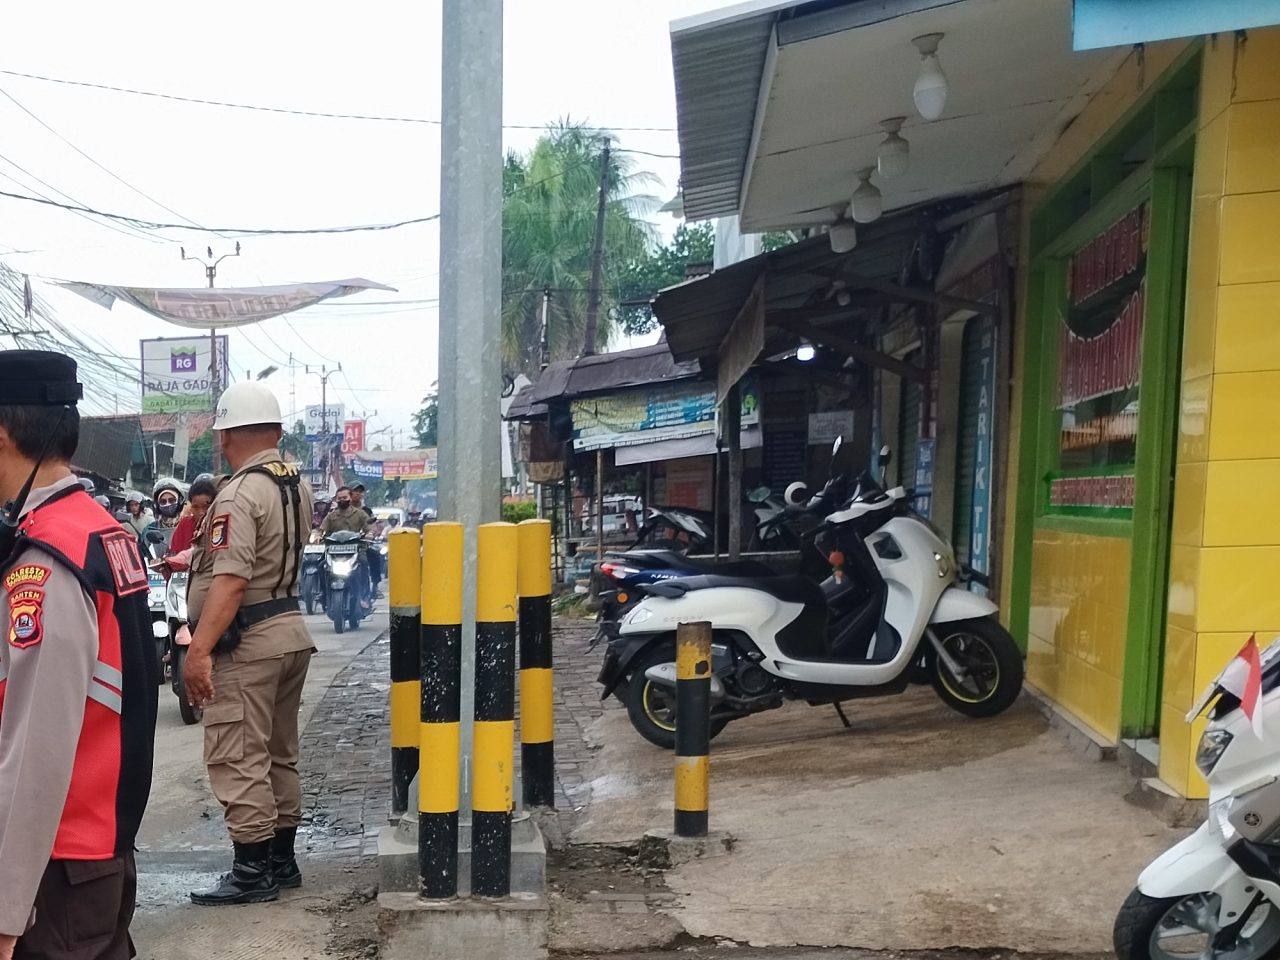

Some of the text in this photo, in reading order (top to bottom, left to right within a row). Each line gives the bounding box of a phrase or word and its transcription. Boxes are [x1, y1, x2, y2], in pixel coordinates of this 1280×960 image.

[176, 358, 192, 368] RG
[148, 380, 212, 392] RAJA GAD
[975, 356, 990, 490] TARIK
[6, 566, 45, 584] POLRESTA
